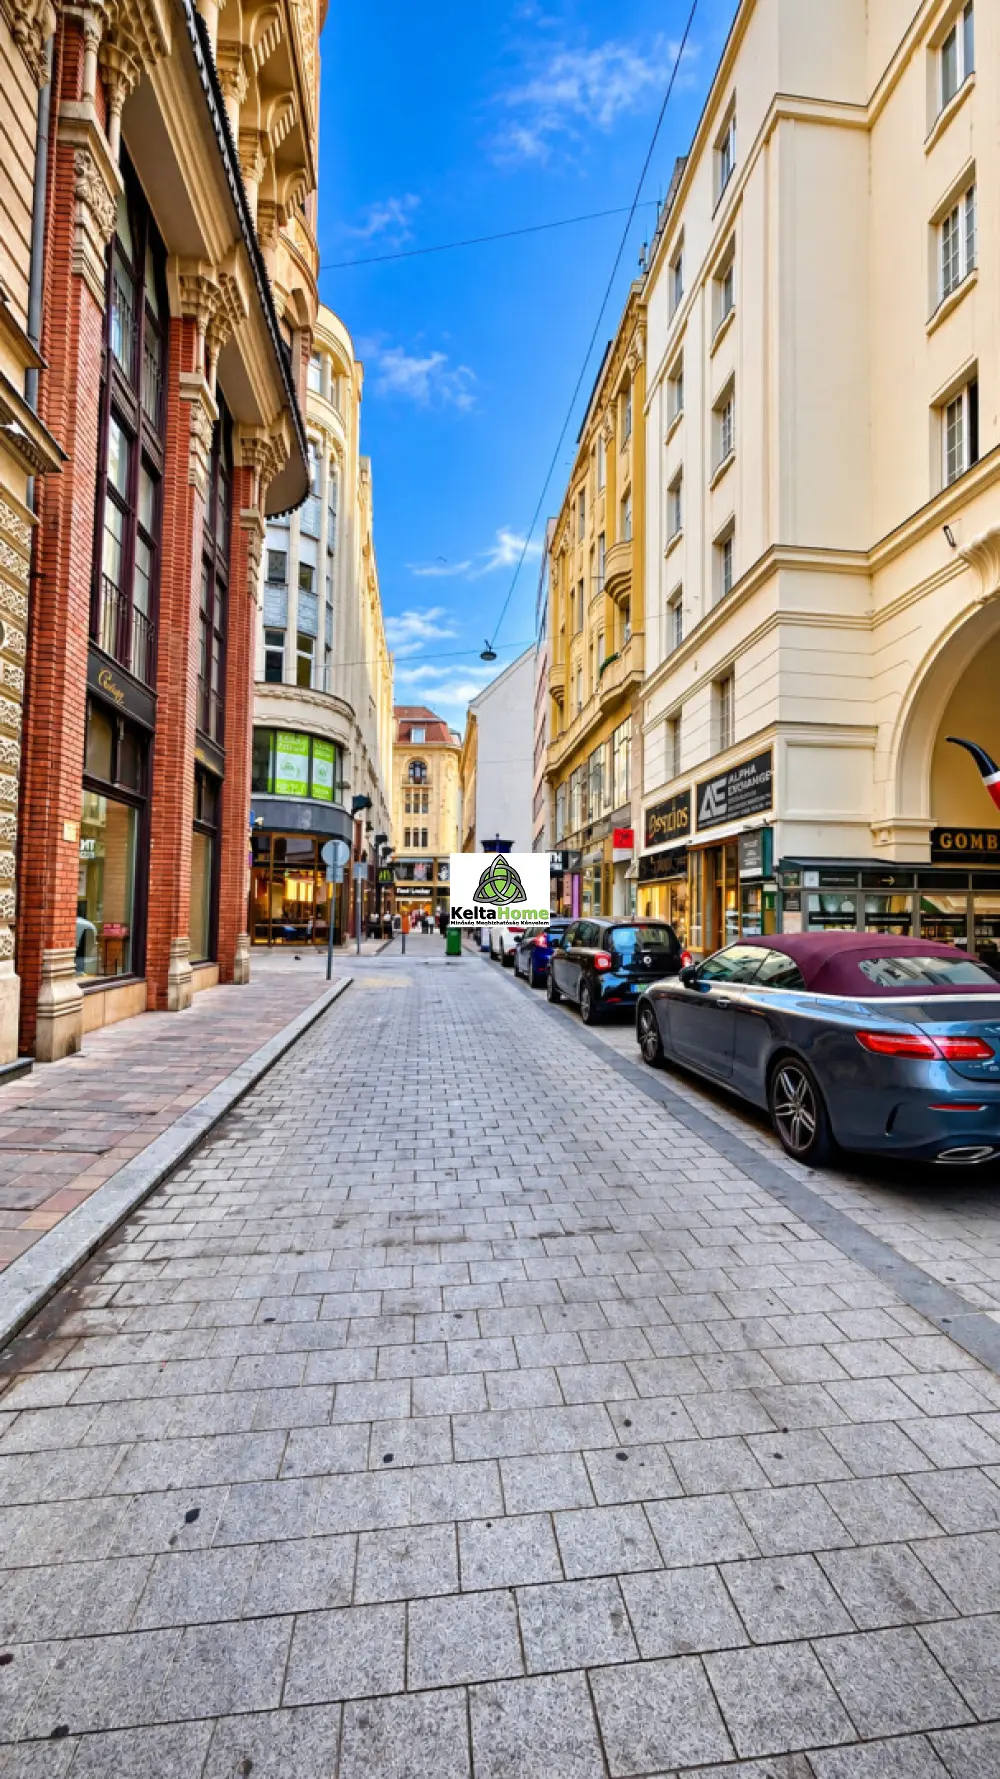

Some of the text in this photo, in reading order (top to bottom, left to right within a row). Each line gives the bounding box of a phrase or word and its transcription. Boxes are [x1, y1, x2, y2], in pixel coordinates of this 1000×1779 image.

[728, 764, 757, 785] ALPHA
[728, 771, 771, 797] EXCHANGE
[940, 833, 998, 849] GOMB
